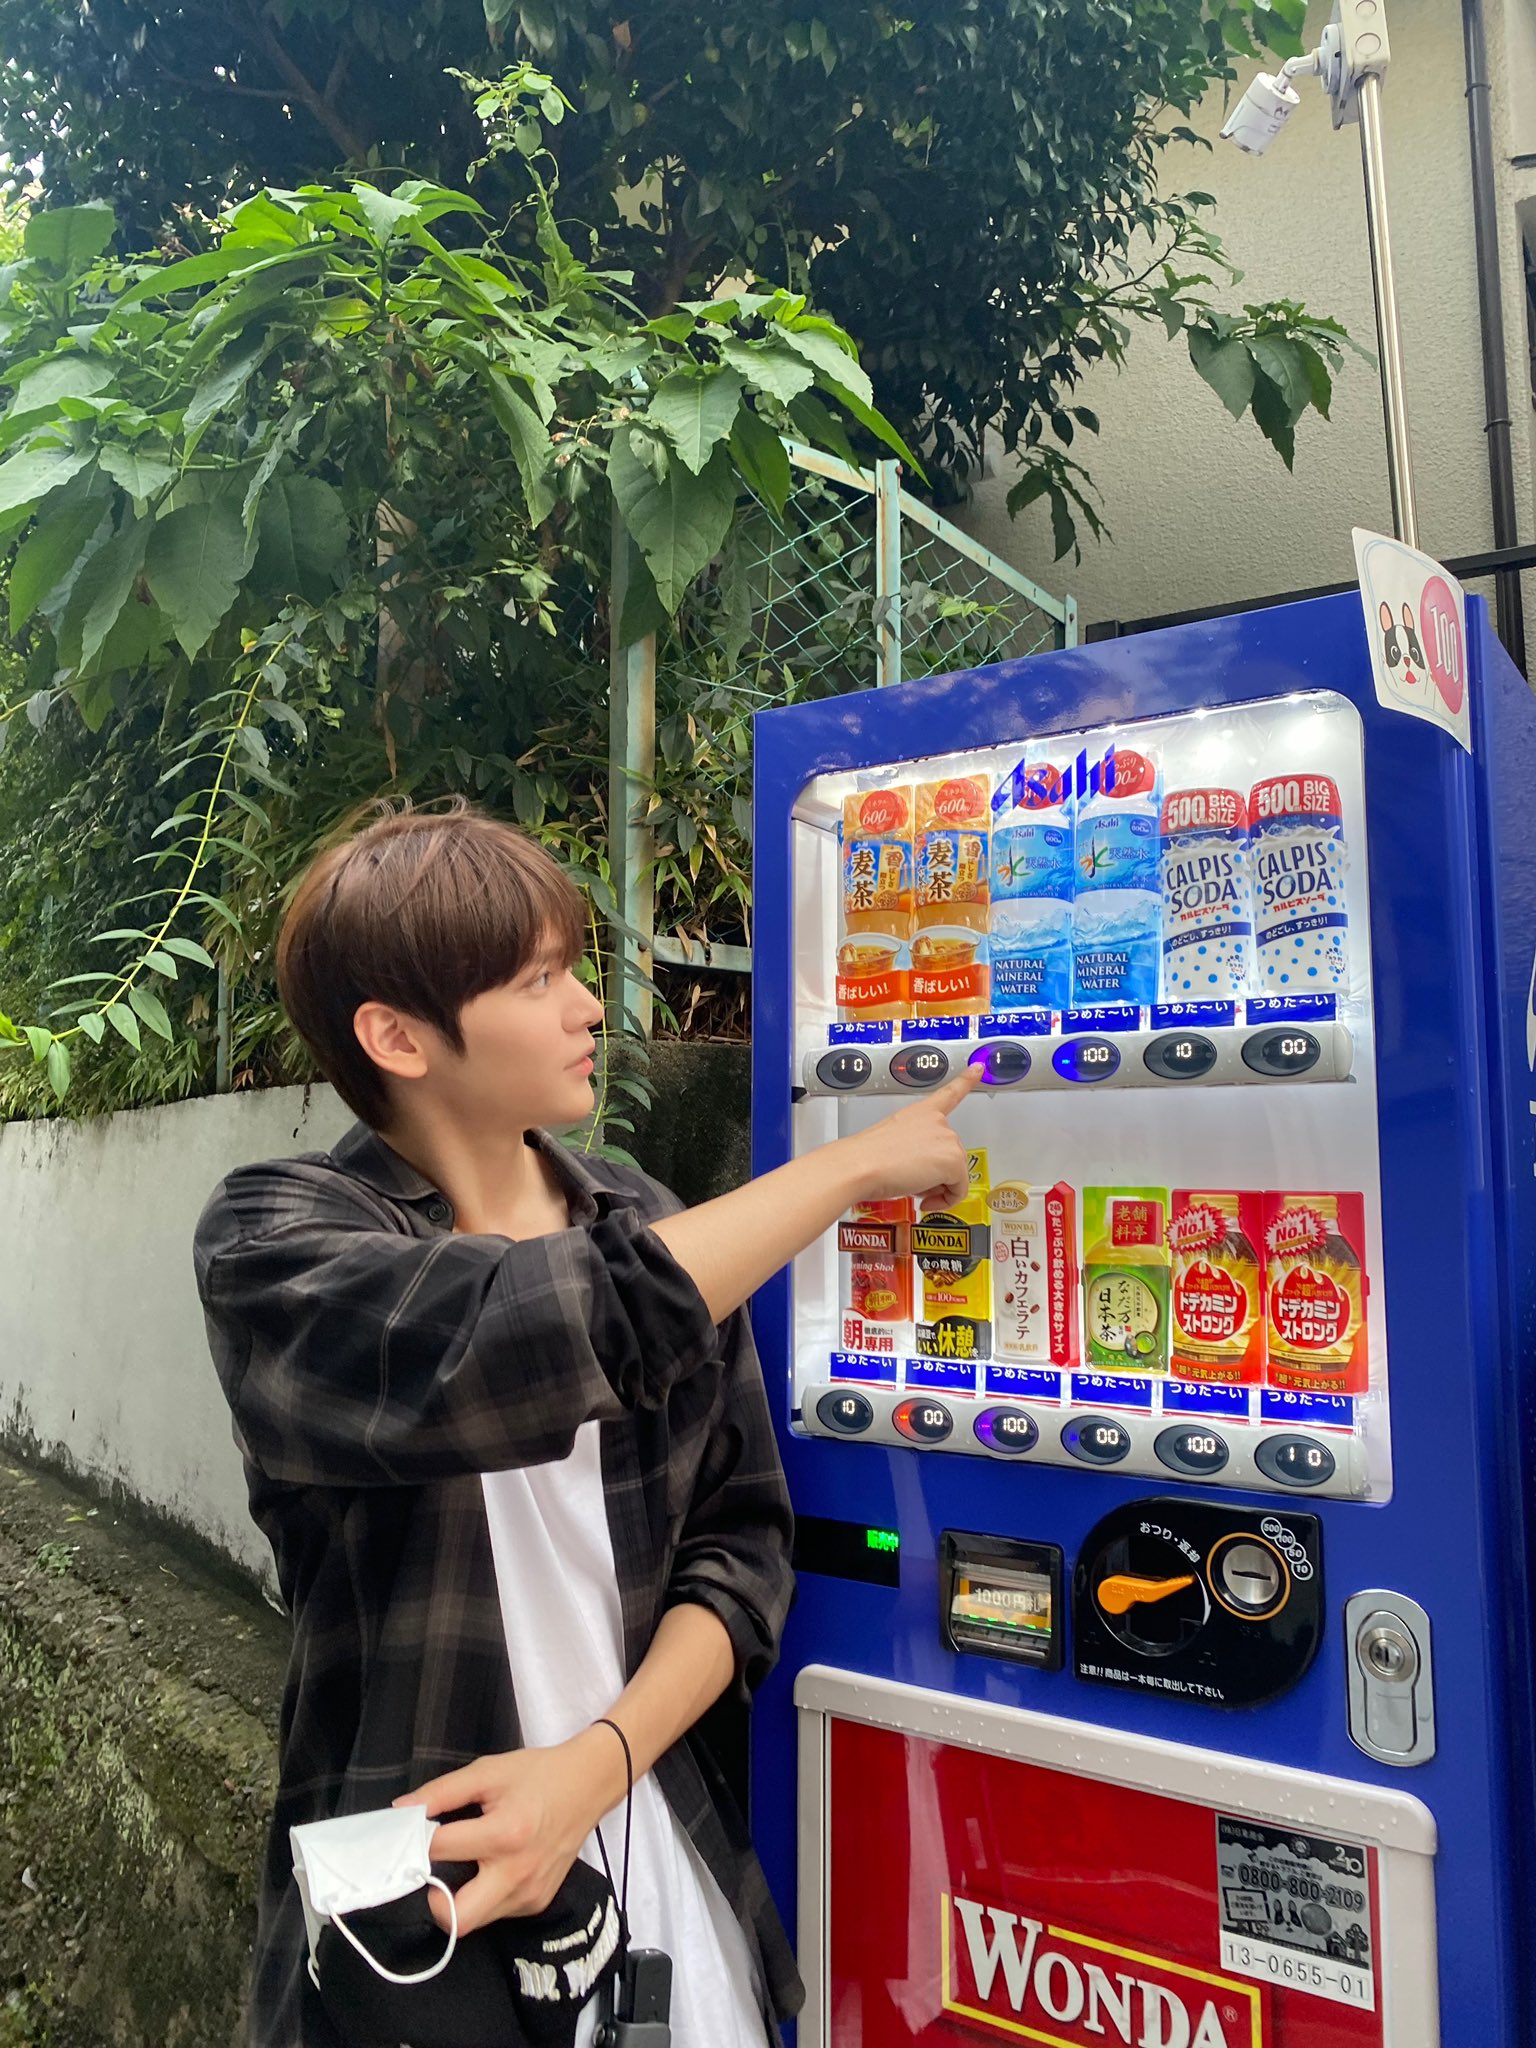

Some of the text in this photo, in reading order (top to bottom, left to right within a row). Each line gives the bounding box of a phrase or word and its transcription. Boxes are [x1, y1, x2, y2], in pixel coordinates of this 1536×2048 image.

[1303, 780, 1330, 796] BIG
[1208, 794, 1236, 808] BIG
[1303, 795, 1330, 812] SIZE
[1208, 808, 1236, 824] SIZE
[927, 840, 953, 899] 麦茶
[1258, 841, 1327, 881] CALPIS
[853, 849, 875, 908] 麦茶
[1166, 853, 1233, 890] CALPIS
[1263, 868, 1333, 906] SODA
[1171, 879, 1238, 915] SODA
[1273, 893, 1326, 913] カルピスソーダ
[1180, 902, 1230, 922] カルピスソーダ
[995, 959, 1045, 970] NATURAL
[1076, 952, 1129, 964] NATURAL
[995, 971, 1044, 982] MINERAL
[1076, 965, 1127, 978] MINERAL
[1001, 984, 1038, 994] WATER
[1082, 977, 1120, 989] WATER
[916, 1054, 939, 1069] 100
[1083, 1046, 1109, 1062] 100
[1116, 1204, 1148, 1222] 老舗
[1115, 1223, 1148, 1241] 料亭
[1177, 1213, 1208, 1239] No.1
[1276, 1215, 1309, 1243] No.1
[842, 1228, 887, 1248] WONDA
[915, 1229, 963, 1248] WONDA
[875, 1262, 895, 1273] Shot
[1010, 1236, 1031, 1340] 白いカフェラテ
[1051, 1217, 1065, 1354] たっぷり飲める大きめサイズ
[1180, 1291, 1238, 1313] ドデカミン
[1278, 1297, 1340, 1321] ドデカミン
[1098, 1287, 1117, 1342] 日本茶
[1182, 1313, 1235, 1336] ストロング
[1281, 1320, 1338, 1343] ストロング
[1002, 1417, 1028, 1433] 100
[1187, 1436, 1216, 1454] 100
[1263, 1523, 1280, 1532] 500
[1278, 1535, 1293, 1544] 100
[1289, 1548, 1302, 1557] 50
[1296, 1565, 1308, 1574] 10
[1238, 1863, 1366, 1914] 0800-800-2109
[953, 1896, 1229, 2048] WONDA
[1227, 1943, 1365, 1998] 13-0655-01
